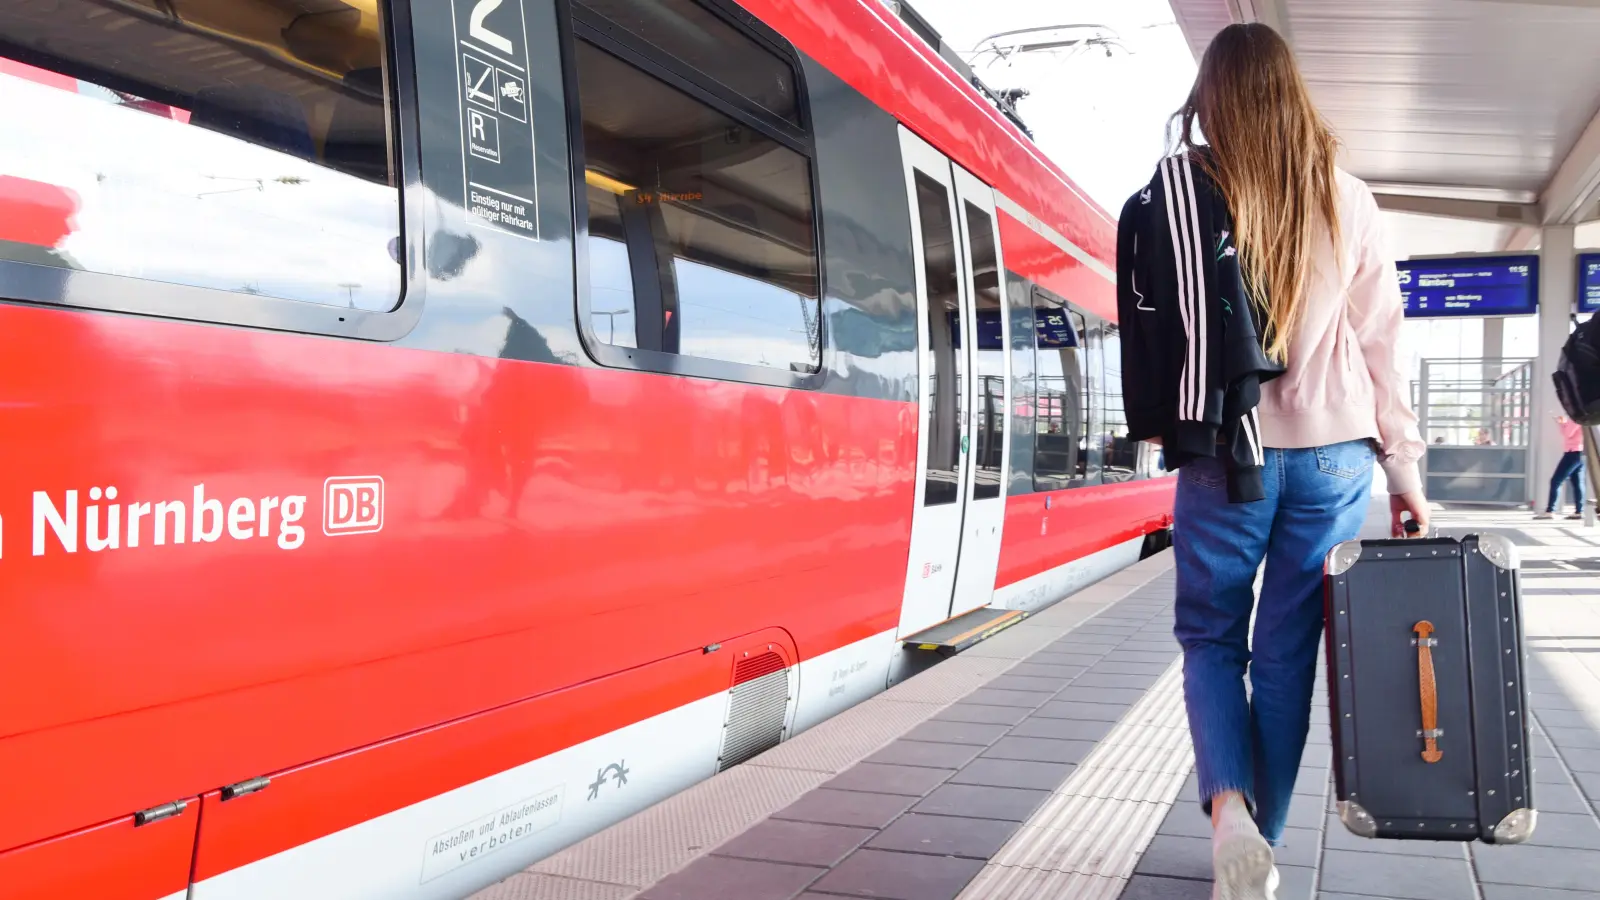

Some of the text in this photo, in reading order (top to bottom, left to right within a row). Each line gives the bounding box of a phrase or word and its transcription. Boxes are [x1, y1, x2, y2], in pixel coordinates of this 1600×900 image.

[470, 0, 513, 55] 2
[471, 112, 485, 141] R
[471, 191, 526, 217] Einstieg nur mit
[471, 205, 533, 231] gültiger Fahrkarte
[32, 482, 308, 556] Nürnberg
[329, 482, 379, 530] DB
[432, 794, 558, 856] Abstoßen und Ablaufenlassen
[459, 822, 532, 861] verboten
